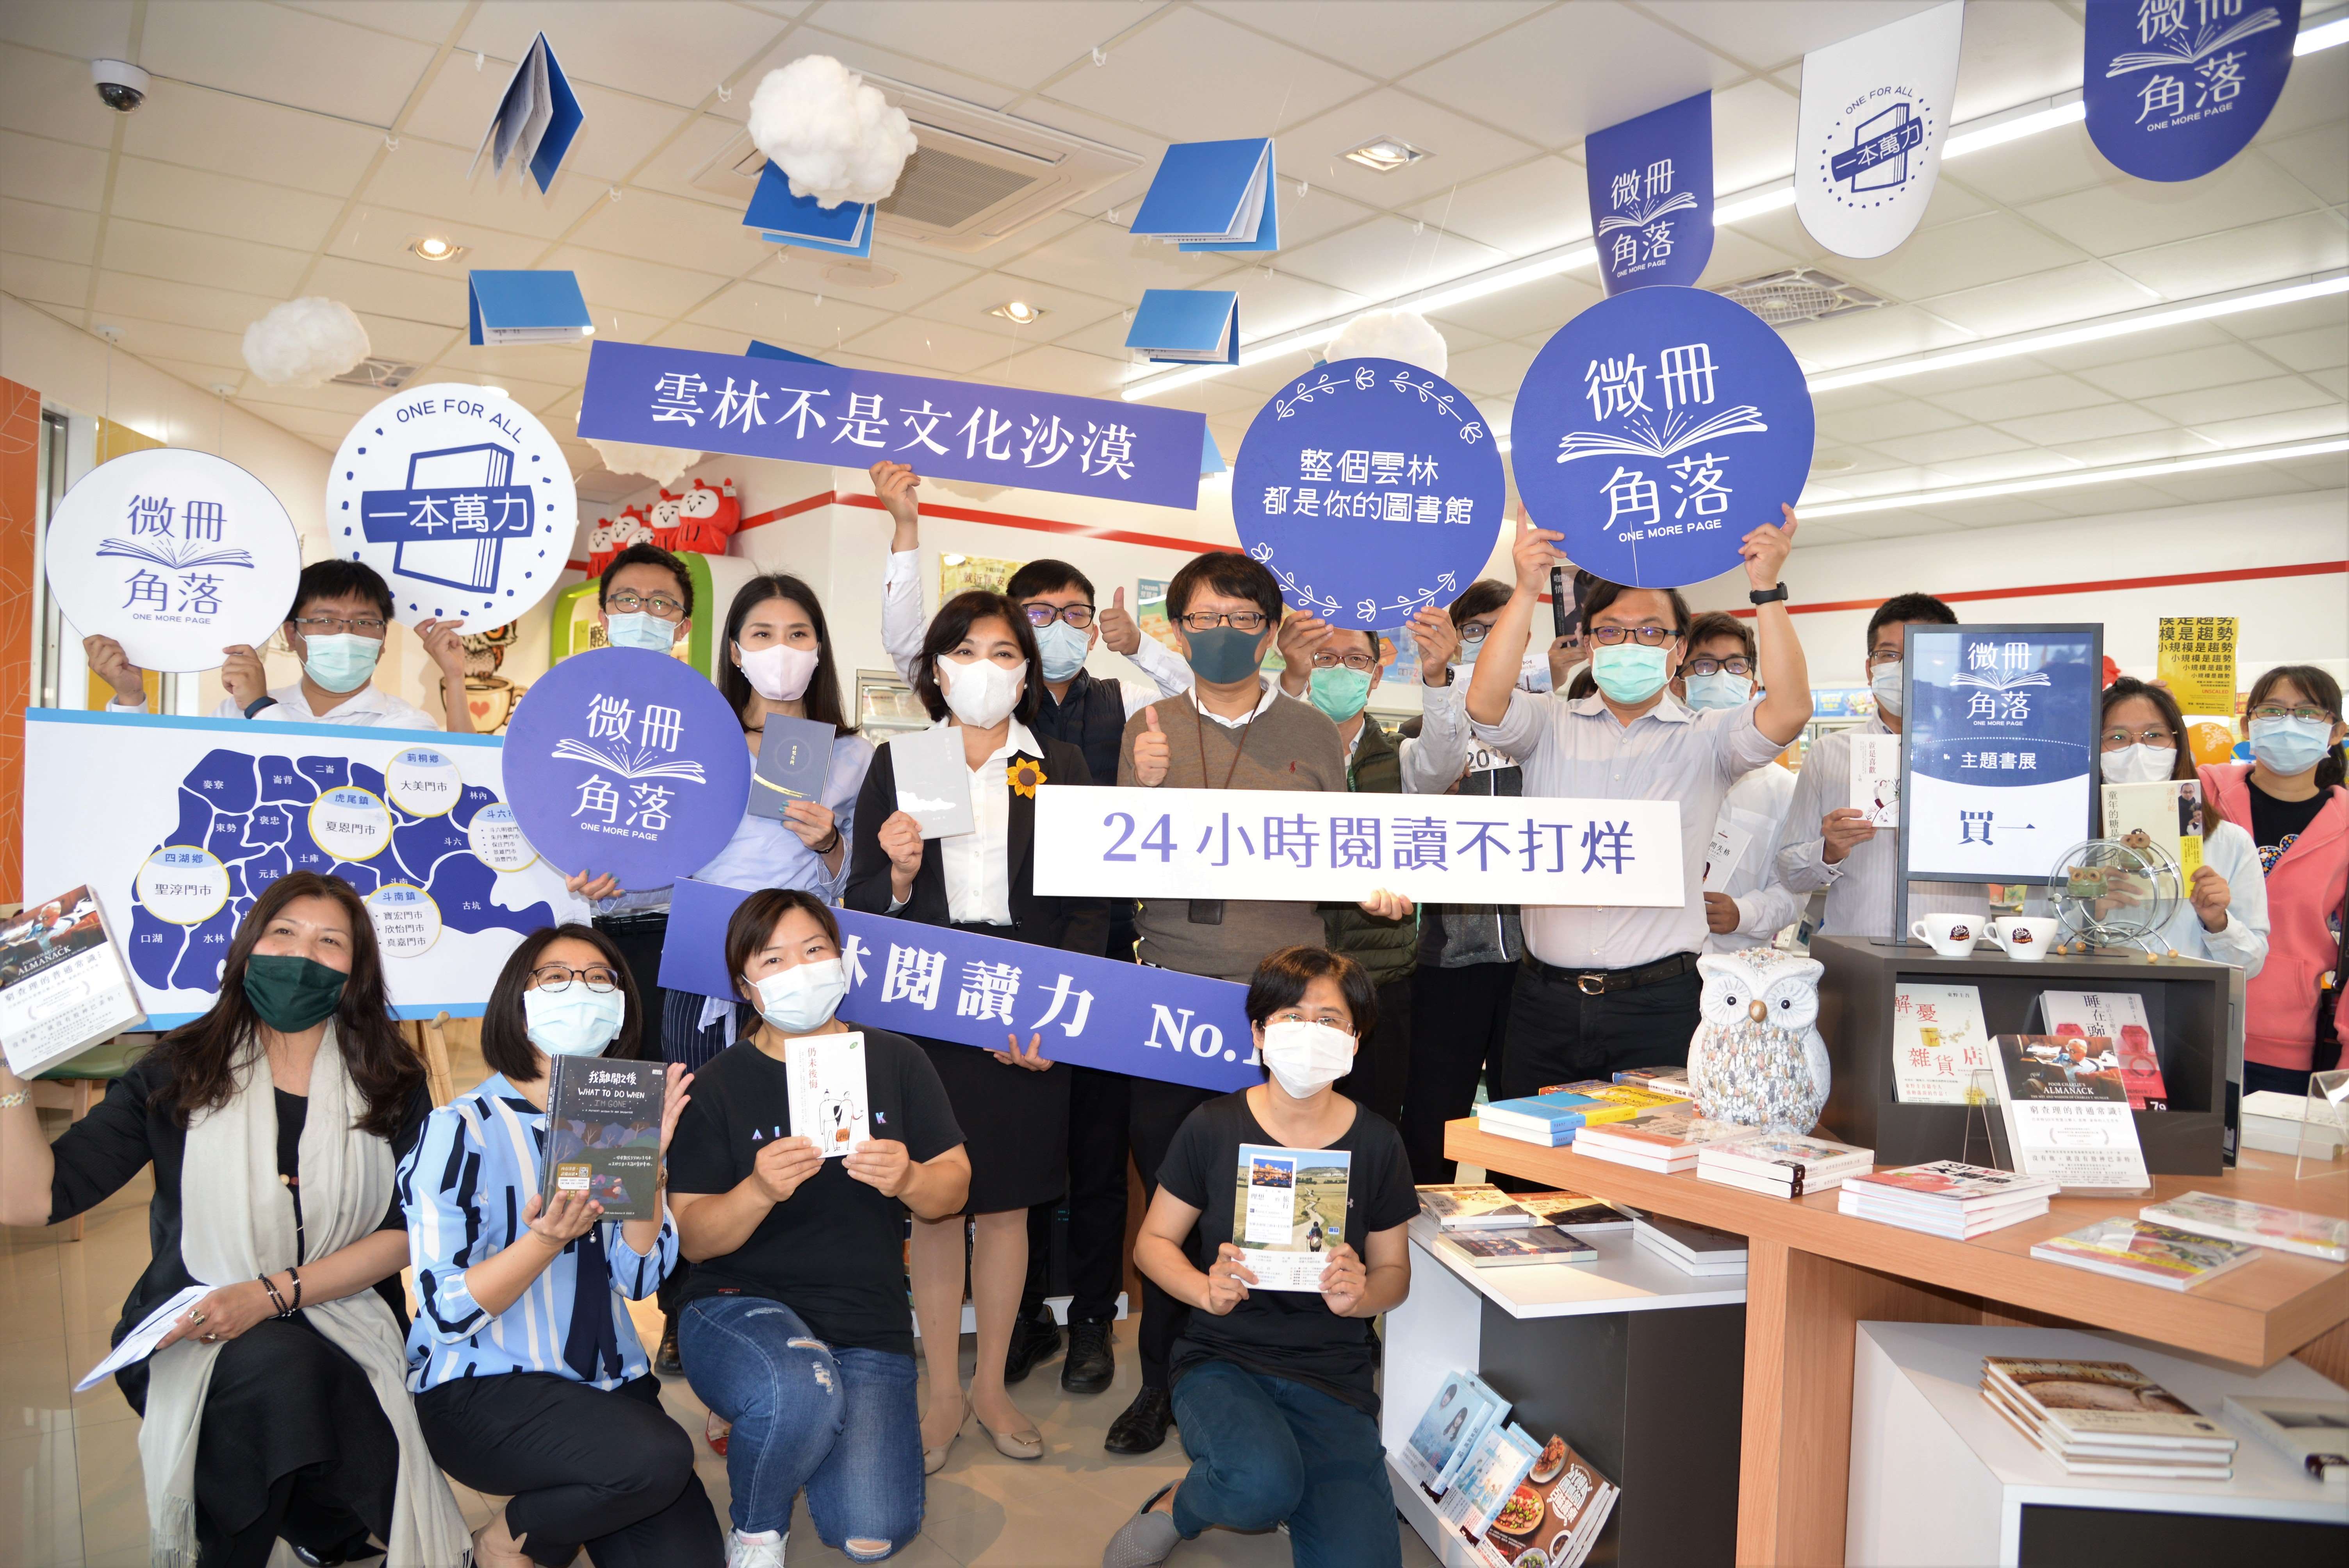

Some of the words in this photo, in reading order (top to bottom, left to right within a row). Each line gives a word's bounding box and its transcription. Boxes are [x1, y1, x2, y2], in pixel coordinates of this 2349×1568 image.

[2135, 52, 2247, 124] 角落
[1846, 96, 1866, 114] ONE
[1870, 86, 1891, 99] FOR
[1895, 86, 1913, 97] ALL
[2147, 121, 2168, 132] ONE
[2172, 112, 2201, 126] MORE
[2204, 102, 2233, 118] PAGE
[1836, 125, 1920, 169] 一本萬力
[1611, 159, 1675, 210] 微冊
[1612, 221, 1674, 272] 角落
[1629, 264, 1645, 274] MORE
[1648, 259, 1666, 268] PAGE
[1584, 343, 1719, 423] 微冊
[397, 400, 436, 422] ONE
[444, 399, 484, 418] FOR
[489, 413, 521, 443] ALL
[650, 372, 1138, 480] 雲林不是文化沙漠
[1300, 449, 1439, 486] 整個雲林
[1599, 452, 1733, 531] 角落
[368, 492, 529, 535] 一本萬力
[1262, 486, 1474, 526] 都是你的圖書館
[128, 495, 227, 542] 微冊
[1618, 531, 1645, 543] ONE
[1648, 524, 1684, 540] MORE
[1687, 519, 1723, 533] PAGE
[122, 568, 225, 614] 角落
[155, 614, 182, 622] MORE
[185, 616, 211, 624] PAGE
[2159, 627, 2233, 641] 模是趨勢
[2158, 642, 2233, 652] 小規模是趨勢
[1968, 642, 2032, 670] 微冊
[2171, 654, 2232, 663] 小規模是趨勢
[1967, 691, 2031, 719] 角落
[586, 693, 684, 752] 微冊
[406, 753, 439, 764] 莿桐鄉
[1961, 752, 2036, 770] 主題書展
[315, 765, 335, 774] 二崙
[203, 780, 224, 789] 麥寮
[273, 775, 293, 785] 崙背
[400, 780, 447, 792] 大美門市
[334, 794, 369, 806] 虎尾鎮
[469, 791, 488, 800] 林內
[571, 773, 675, 831] 角落
[215, 823, 237, 833] 東勢
[259, 816, 281, 826] 褒忠
[324, 820, 376, 836] 夏恩門市
[1957, 809, 2035, 846] 買一
[581, 823, 600, 832] ONE
[602, 826, 629, 837] MORE
[632, 831, 658, 841] PAGE
[444, 837, 462, 846] 斗六
[165, 853, 203, 863] 四湖鄉
[299, 854, 319, 864] 土庫
[258, 870, 279, 879] 元長
[155, 883, 212, 896] 聖淳門市
[382, 891, 416, 901] 斗南鎮
[462, 902, 481, 911] 古坑
[383, 911, 422, 920] 寶宏門市
[384, 924, 424, 934] 欣怡門市
[141, 933, 163, 944] 口湖
[203, 933, 225, 944] 水林
[18, 946, 71, 975] ALMANACK
[22, 955, 38, 965] POOR
[1895, 995, 1938, 1022] 解憂
[808, 1047, 818, 1089] 仍未後悔
[588, 1070, 637, 1085] 我離開之後
[578, 1087, 600, 1096] WHAT
[602, 1089, 611, 1098] TO
[626, 1090, 645, 1099] WHEN
[2030, 1106, 2117, 1115] 窮查理的普通常識
